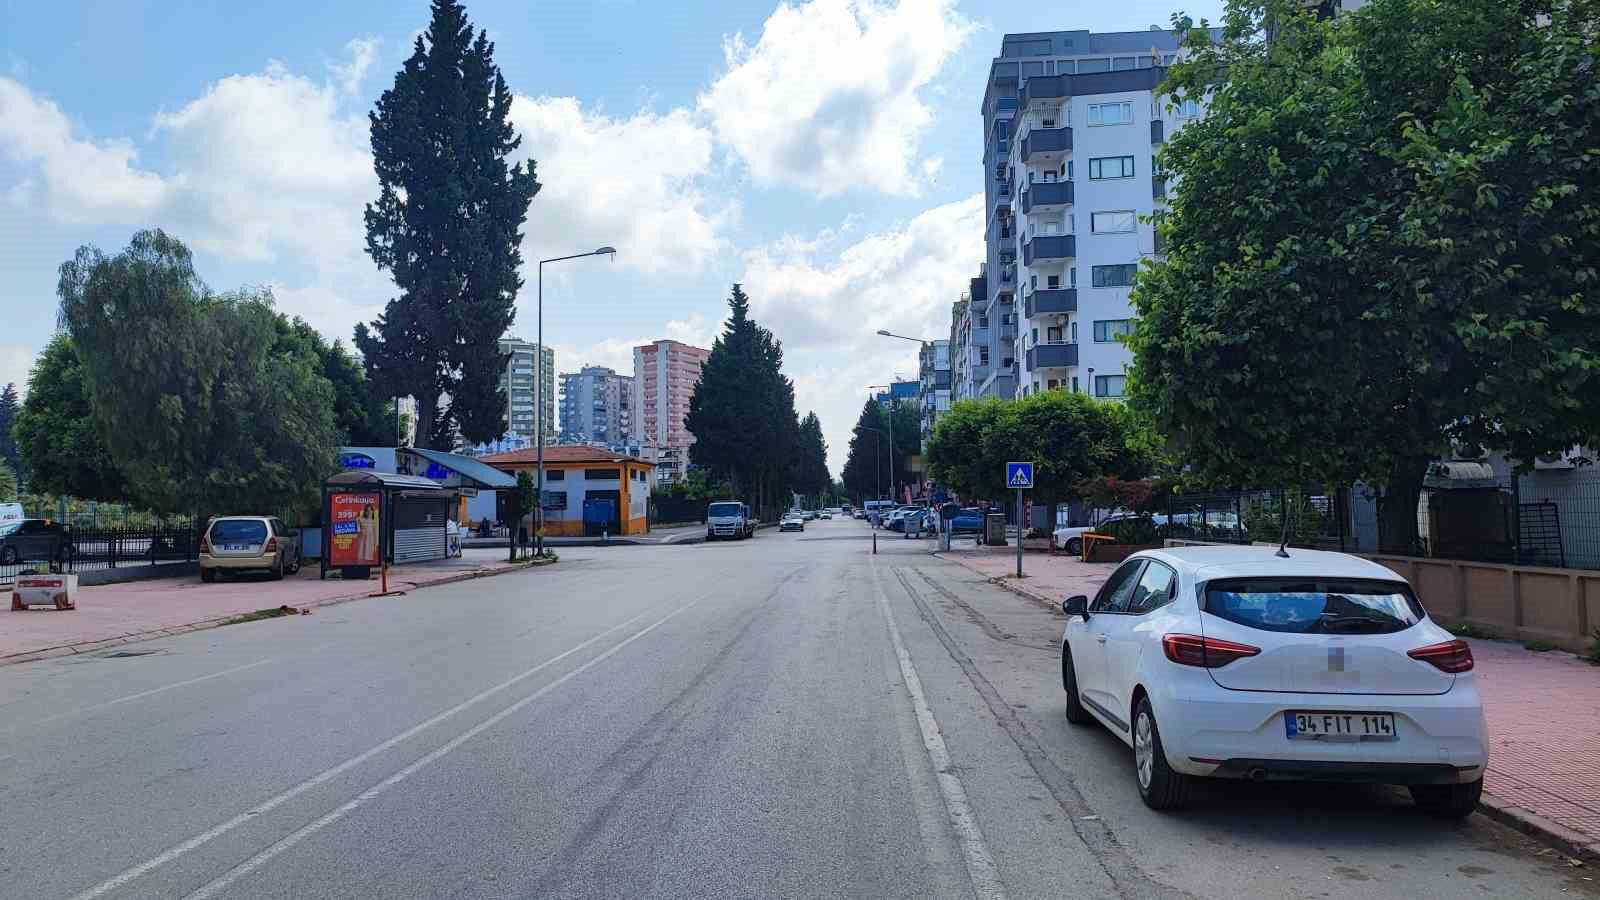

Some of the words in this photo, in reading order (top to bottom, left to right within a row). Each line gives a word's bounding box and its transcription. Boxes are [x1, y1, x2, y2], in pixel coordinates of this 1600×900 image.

[1297, 715, 1317, 733] 34
[1323, 716, 1352, 733] FIT
[1361, 716, 1390, 734] 114
